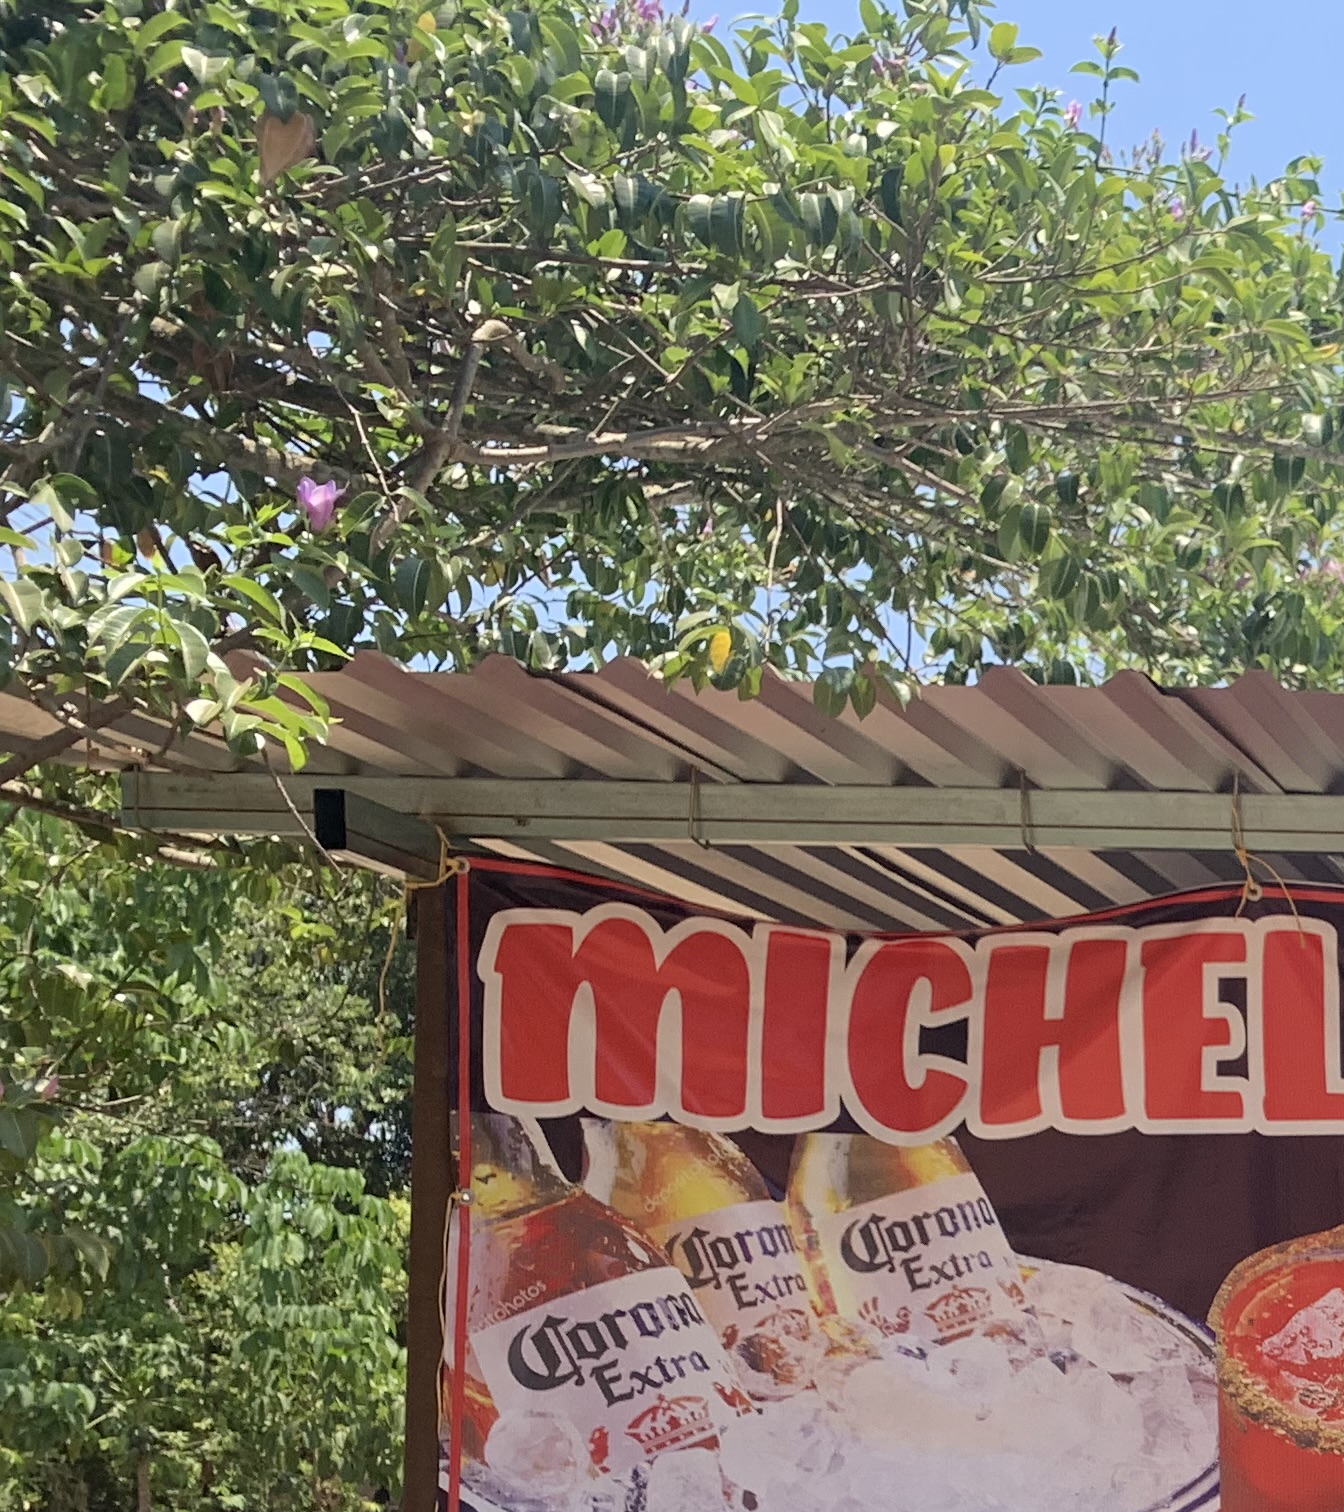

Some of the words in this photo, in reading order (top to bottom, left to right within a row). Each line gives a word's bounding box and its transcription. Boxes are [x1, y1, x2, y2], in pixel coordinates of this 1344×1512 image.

[664, 1223, 797, 1291] Coron
[841, 1196, 996, 1274] Corona
[900, 1250, 993, 1292] Extra
[590, 1350, 710, 1408] Extra
